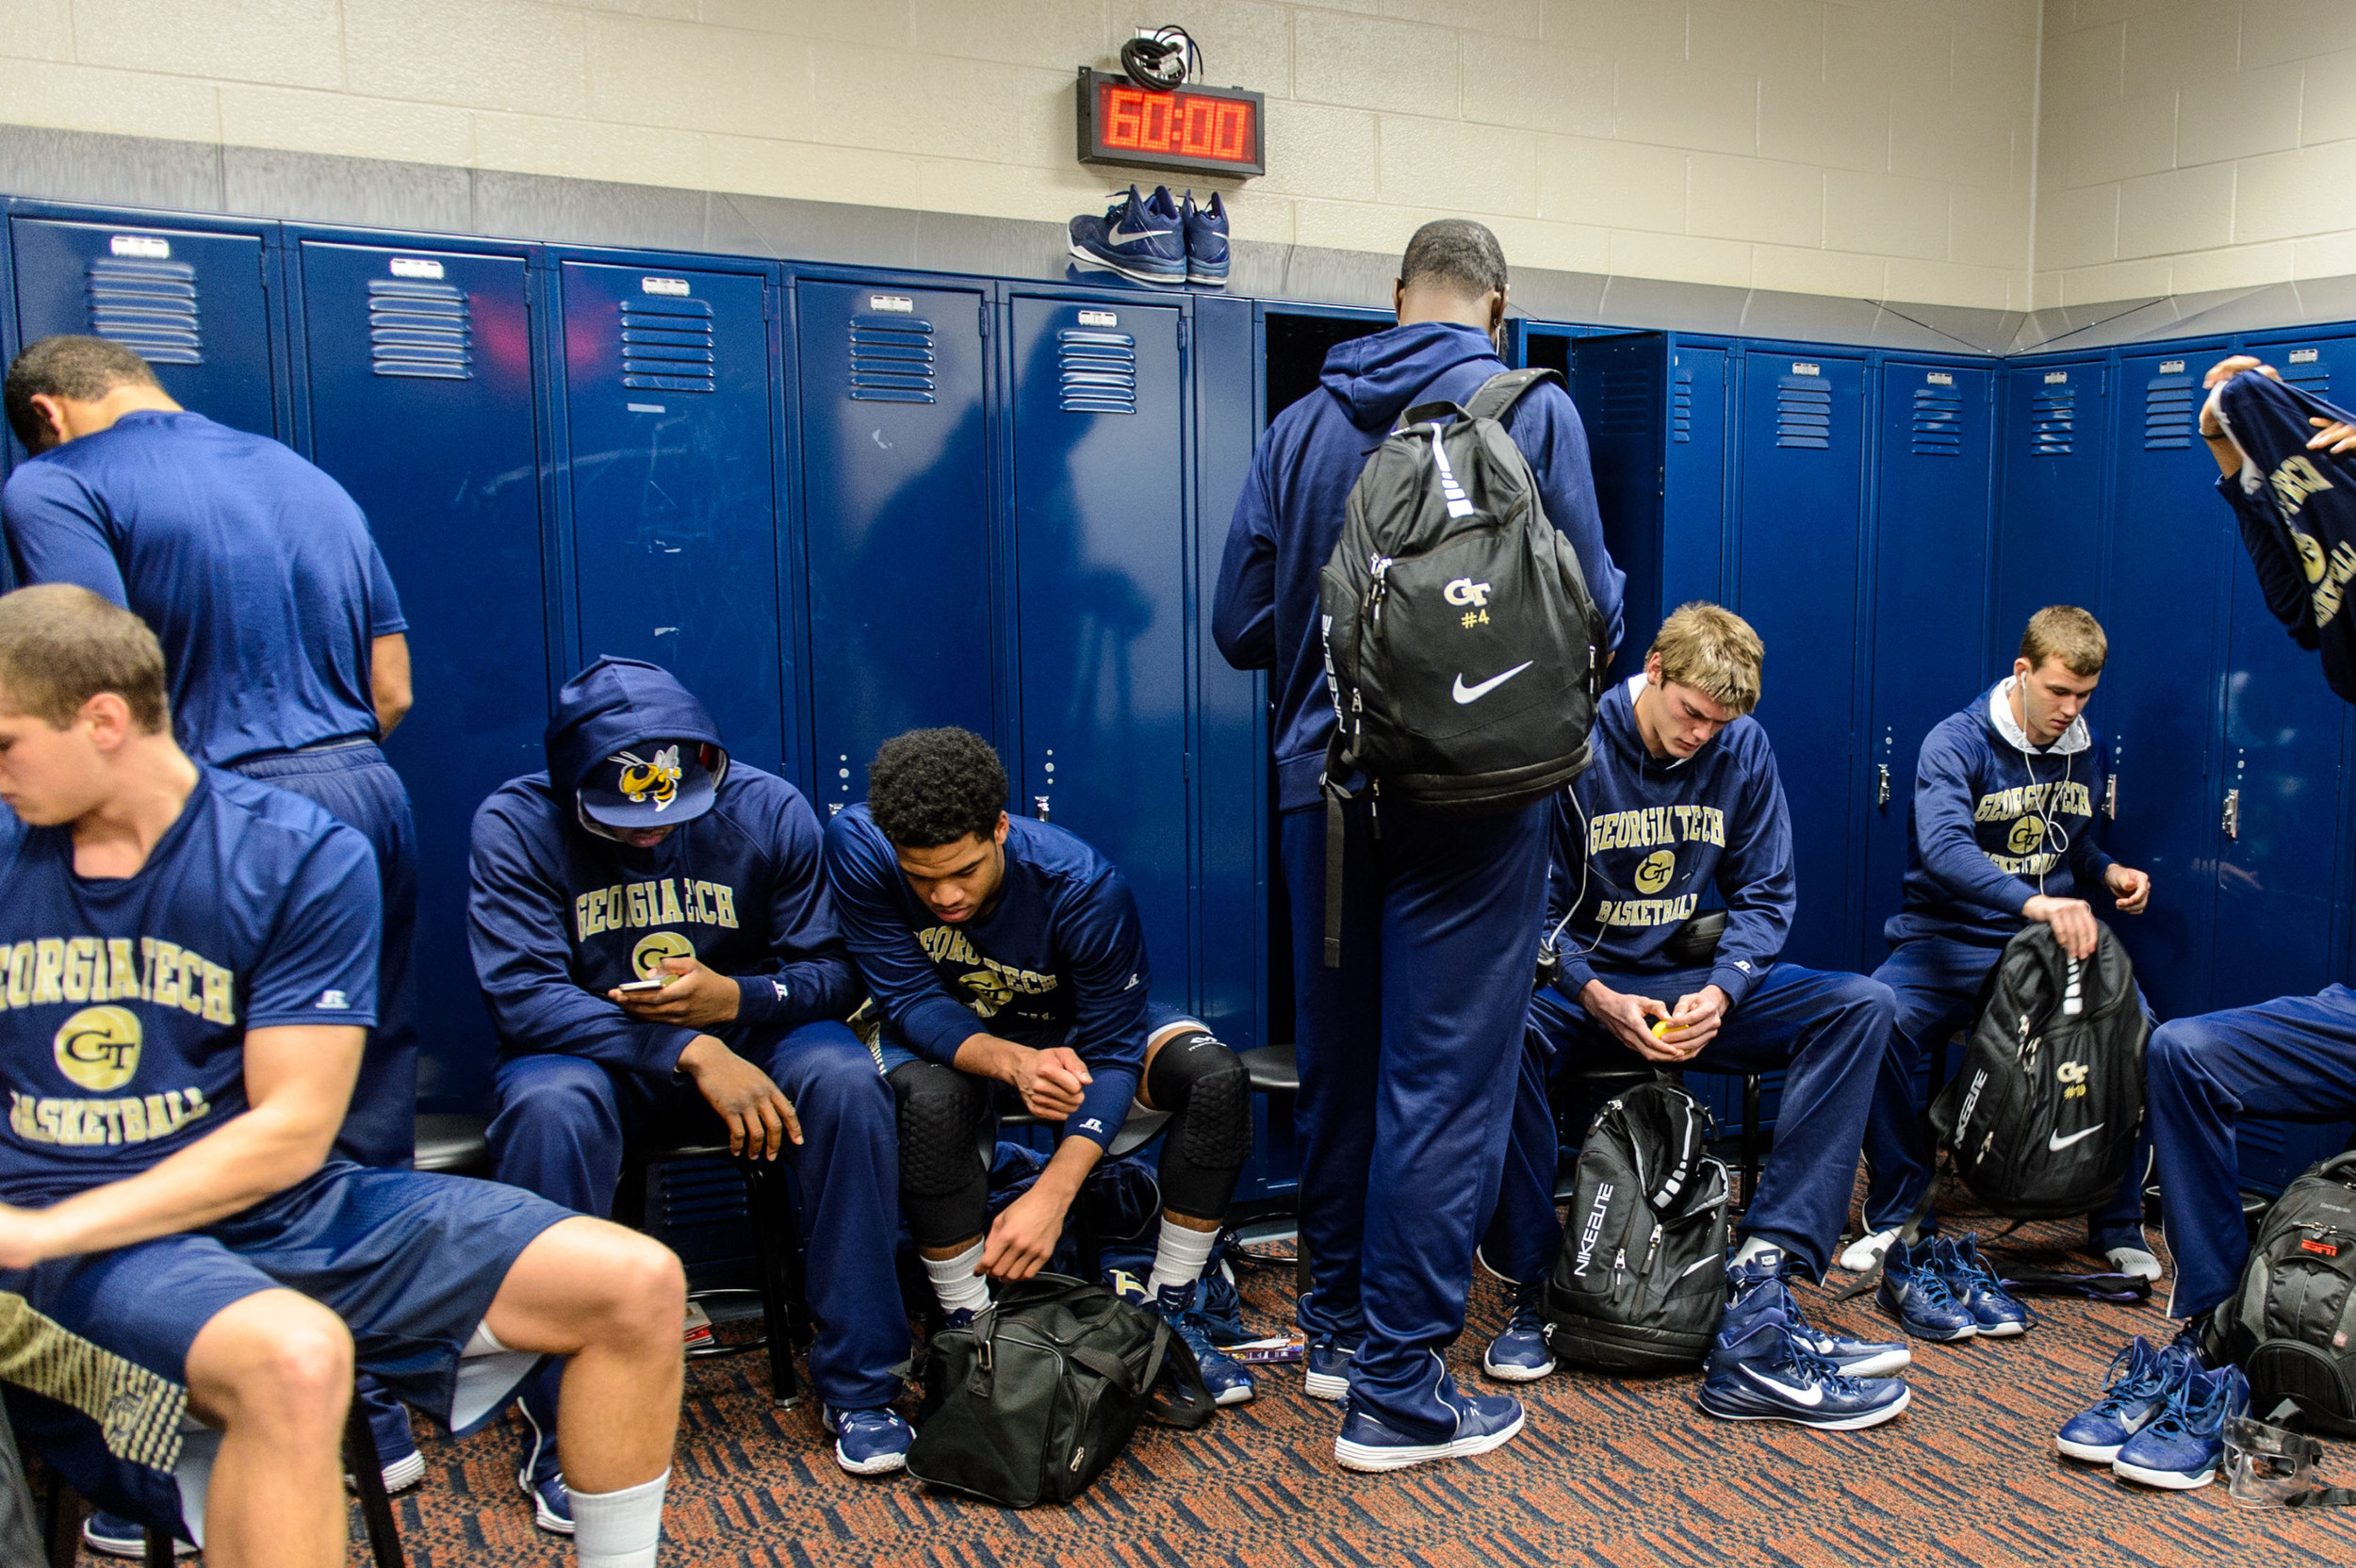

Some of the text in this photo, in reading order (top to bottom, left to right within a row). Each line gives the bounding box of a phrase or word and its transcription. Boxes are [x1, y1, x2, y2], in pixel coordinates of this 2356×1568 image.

[1106, 88, 1247, 160] 60:00
[1444, 578, 1492, 608] GT
[1461, 609, 1491, 629] #4
[1590, 805, 1726, 856] GEORGIA TECH
[1639, 861, 1673, 883] GT
[65, 1029, 137, 1070] GT
